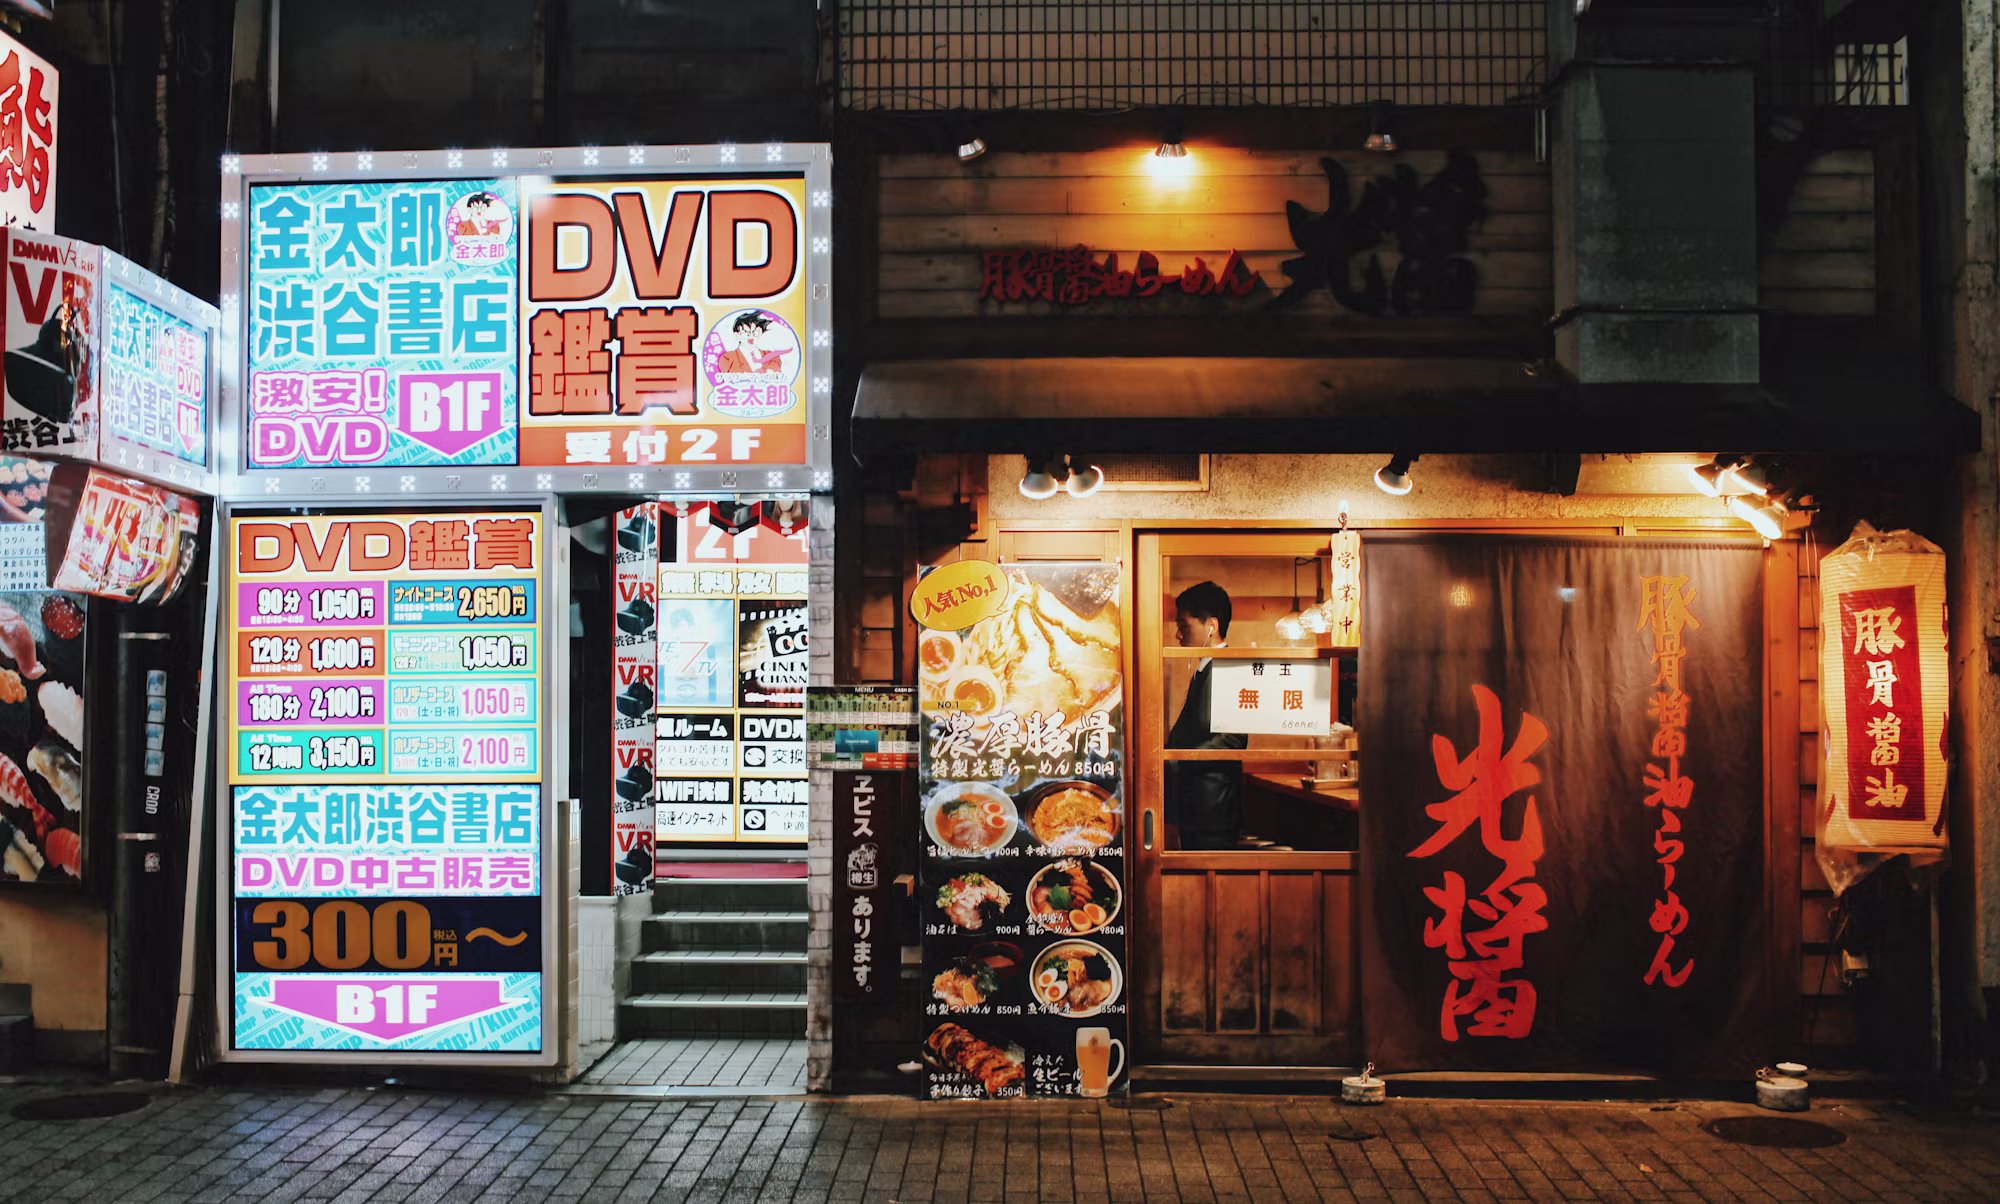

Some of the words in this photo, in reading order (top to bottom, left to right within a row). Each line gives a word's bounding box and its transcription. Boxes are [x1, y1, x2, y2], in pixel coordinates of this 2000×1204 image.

[259, 192, 443, 270] 金太郎
[528, 189, 798, 301] DVD
[13, 238, 58, 262] DMM
[455, 243, 505, 259] 金太郎
[111, 297, 158, 373] 金太郎
[258, 280, 509, 358] 渋谷書店
[529, 306, 699, 416] 鑑賞
[177, 365, 203, 402] DVD
[253, 369, 387, 414] 激安!
[716, 384, 789, 408] 金太郎
[410, 381, 491, 432] B1F
[252, 415, 389, 463] DVD
[565, 428, 761, 463] 受付2F
[238, 518, 534, 573] DVD鑑賞
[258, 588, 301, 614] 90分
[309, 589, 374, 621] 1,050円
[394, 586, 454, 602] ナイトコース
[458, 586, 527, 620] 2,650円
[618, 582, 655, 603] VR
[1337, 551, 1356, 636] 営業中
[250, 636, 301, 663] 120分
[309, 638, 374, 671] 1,600円
[460, 635, 527, 670] 1,050円
[1251, 662, 1292, 676] 替玉
[618, 665, 654, 685] VR
[249, 695, 301, 721] 180分
[310, 687, 374, 720] 2,100円
[462, 687, 525, 717] 1,050円
[937, 701, 959, 709] NO.1
[1238, 688, 1304, 710] 無限
[1854, 607, 1908, 809] 豚骨醤油
[929, 710, 1117, 759] 濃厚豚骨
[309, 736, 374, 770] 3,150円
[462, 737, 525, 767] 2,100円
[617, 748, 653, 769] VR
[930, 760, 1070, 778] 特製光醤らーめん
[1074, 762, 1116, 776] 850円
[1636, 574, 1701, 988] 豚骨醤油らーめん
[239, 792, 533, 845] 金太郎渋谷書店
[616, 832, 654, 852] VR
[1098, 847, 1123, 857] 850円
[241, 856, 532, 889] DVD中古販売
[433, 929, 457, 941] 税込
[852, 896, 873, 992] あります。
[925, 924, 958, 935] 油そば
[995, 925, 1021, 935] 900円
[1099, 925, 1124, 936] 980円
[337, 984, 438, 1024] B1F
[925, 1004, 991, 1015] 特製つけめん
[996, 1005, 1022, 1015] 850円
[1101, 1005, 1126, 1014] 850円
[930, 1084, 984, 1098] 手作り餃子
[997, 1086, 1023, 1097] 350円
[1033, 1068, 1084, 1082] 生ビール
[1035, 1083, 1083, 1094] ございます
